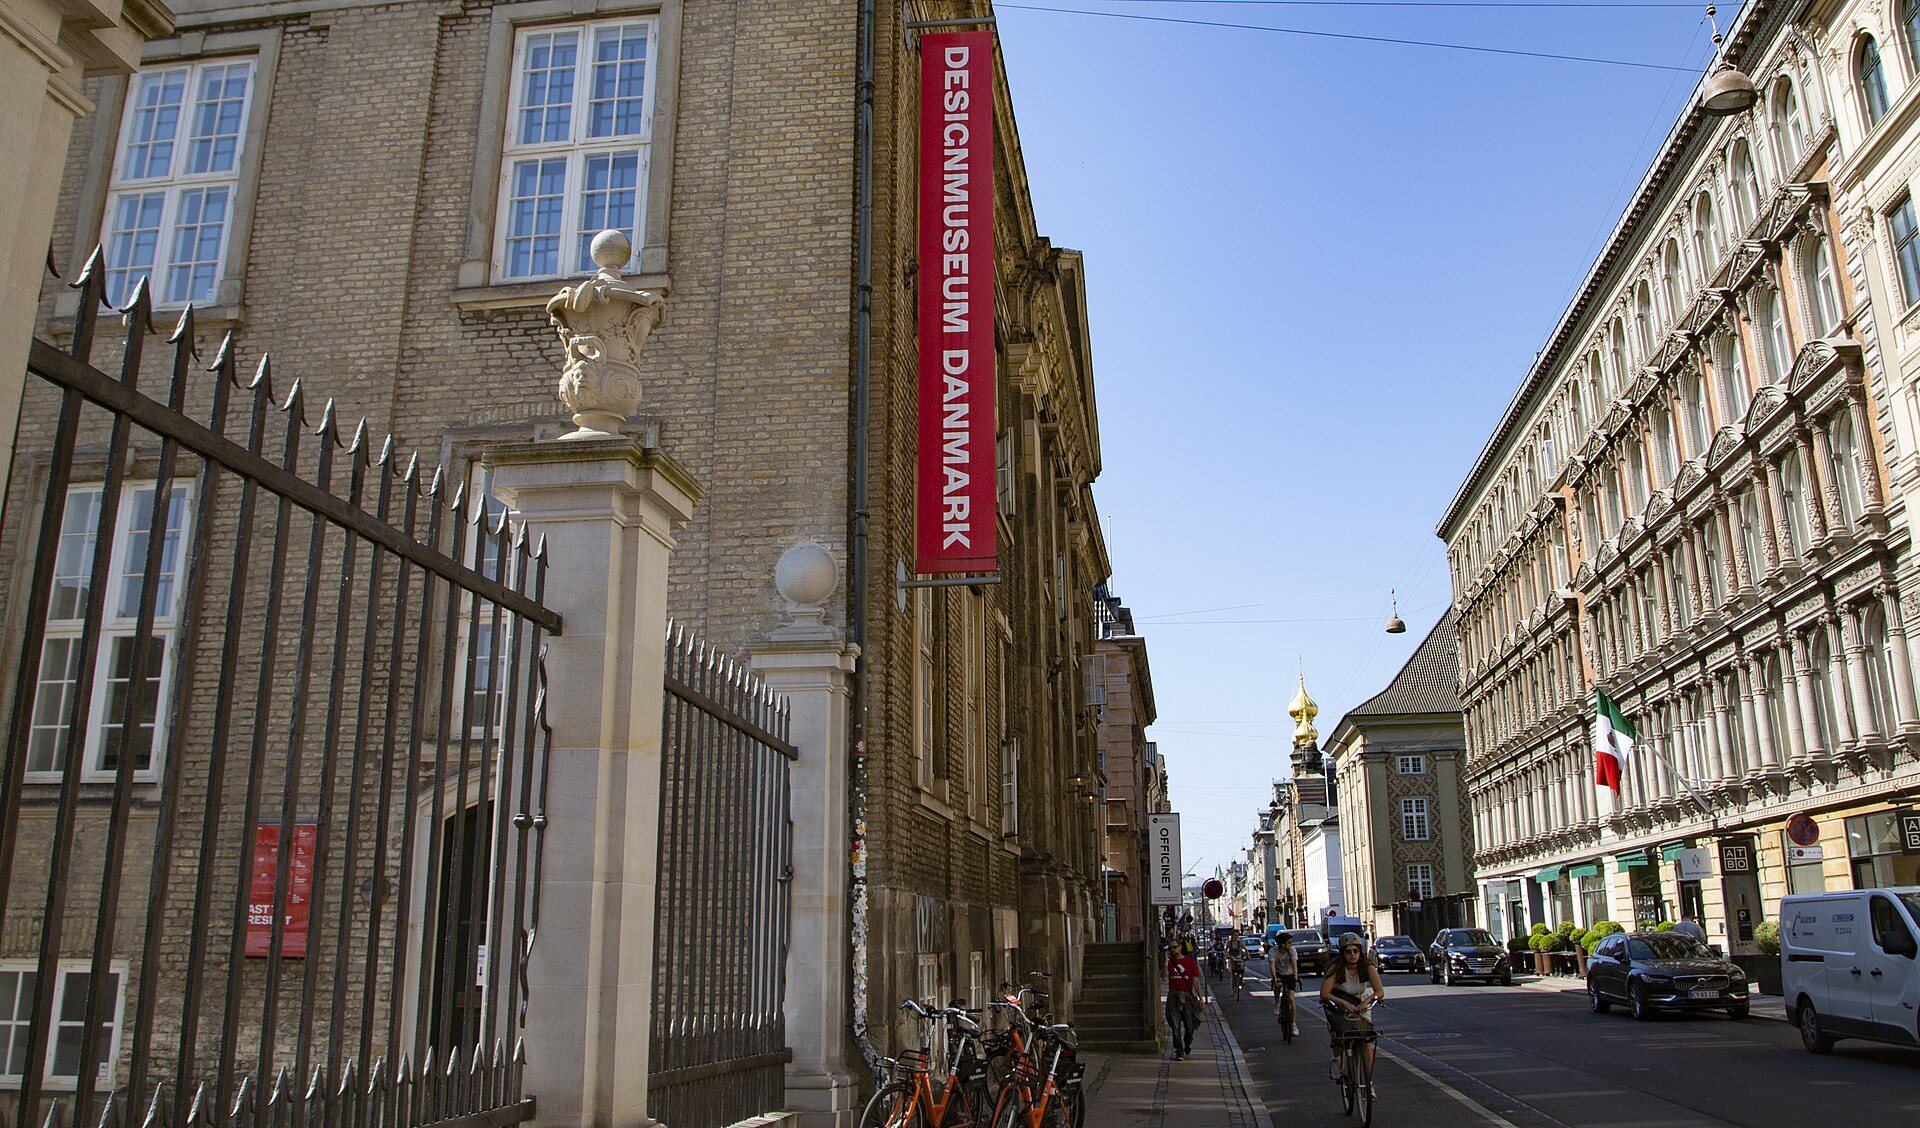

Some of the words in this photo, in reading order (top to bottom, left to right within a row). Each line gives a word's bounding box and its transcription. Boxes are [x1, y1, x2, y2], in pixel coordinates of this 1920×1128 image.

[943, 47, 969, 333] DESIGNMUSEUM
[943, 349, 971, 551] DANMARK
[1159, 827, 1171, 892] OFFICINET
[248, 904, 270, 915] AST
[248, 915, 292, 926] REST
